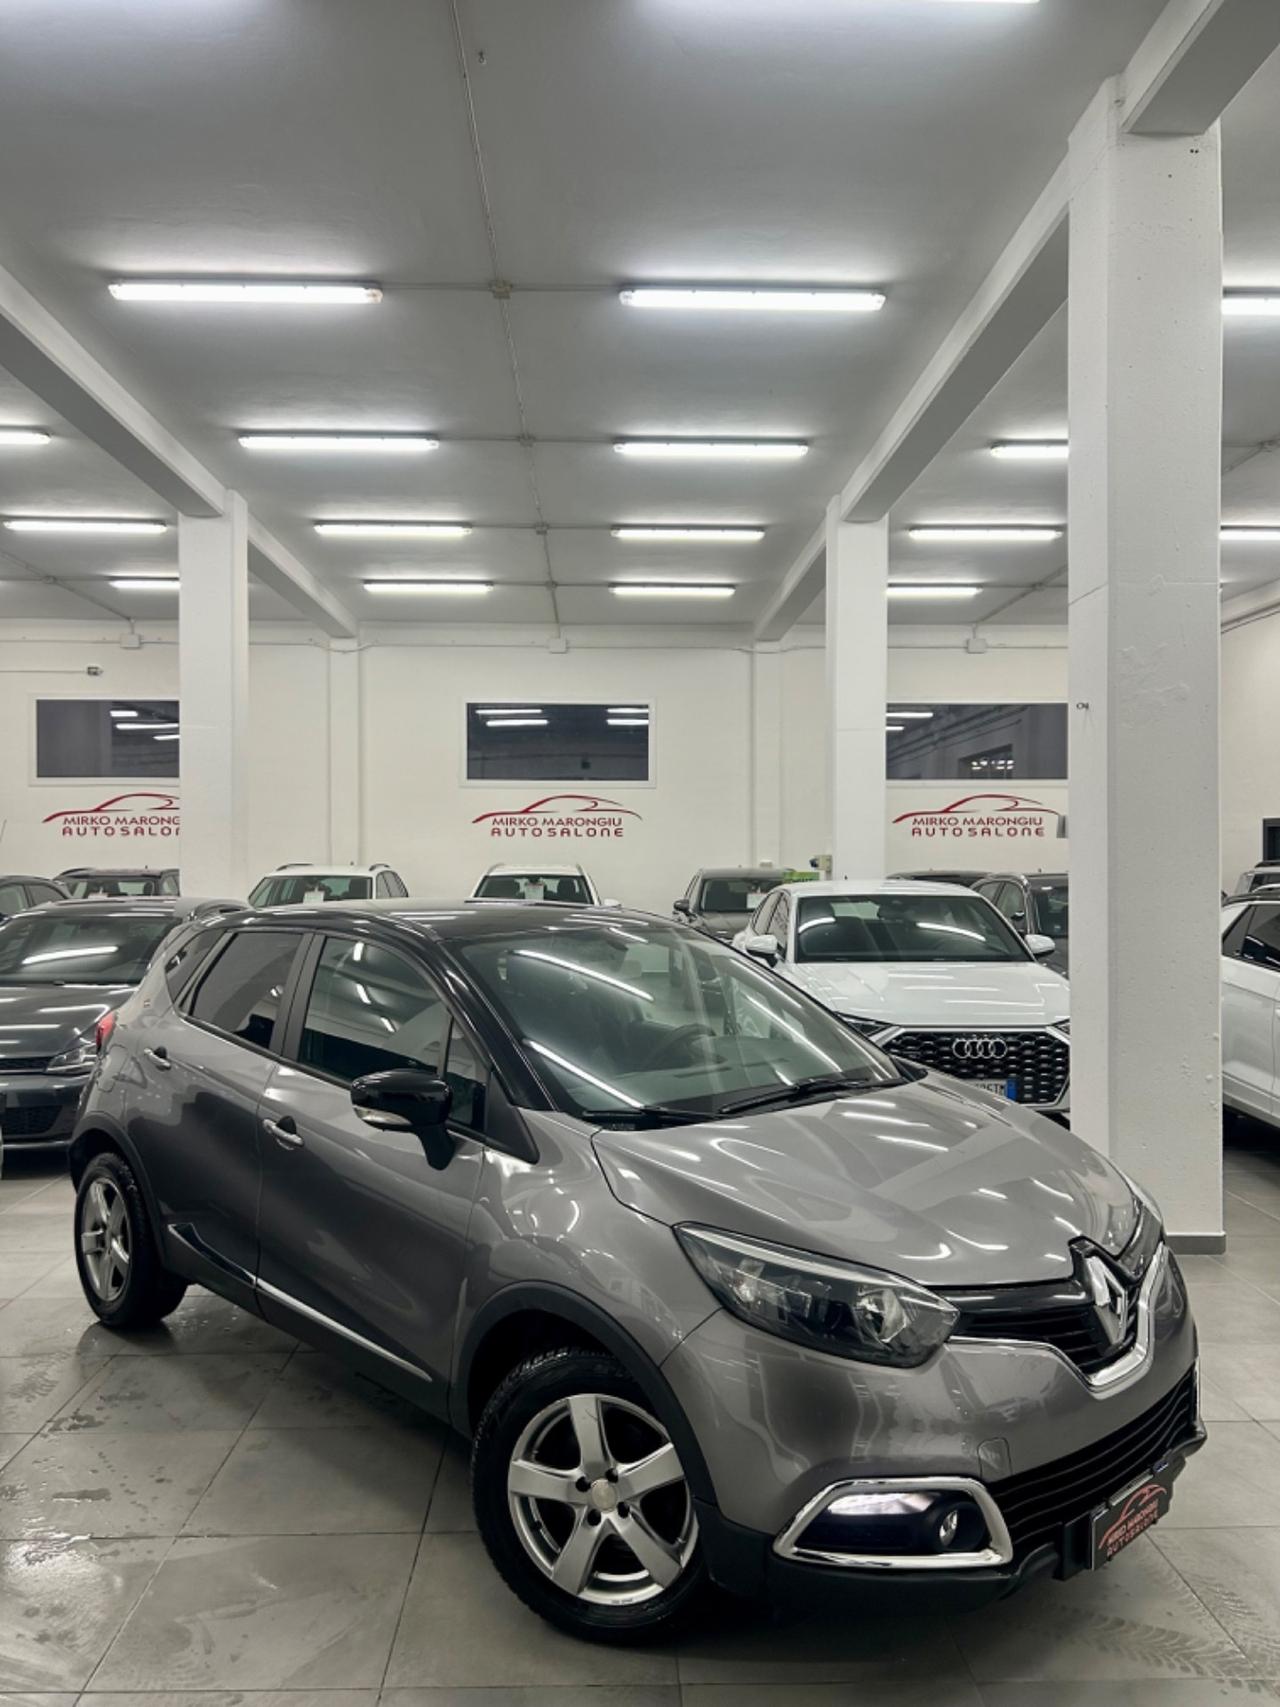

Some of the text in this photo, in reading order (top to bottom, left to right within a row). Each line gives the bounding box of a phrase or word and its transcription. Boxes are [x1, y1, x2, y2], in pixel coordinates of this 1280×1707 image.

[63, 816, 111, 825] MIRKO
[492, 817, 622, 826] MIRKO MARONGIU
[912, 817, 1042, 826] MIRKO MARONGIU
[491, 827, 624, 838] AUTOSALONE
[911, 827, 1045, 837] AUTOSALONE
